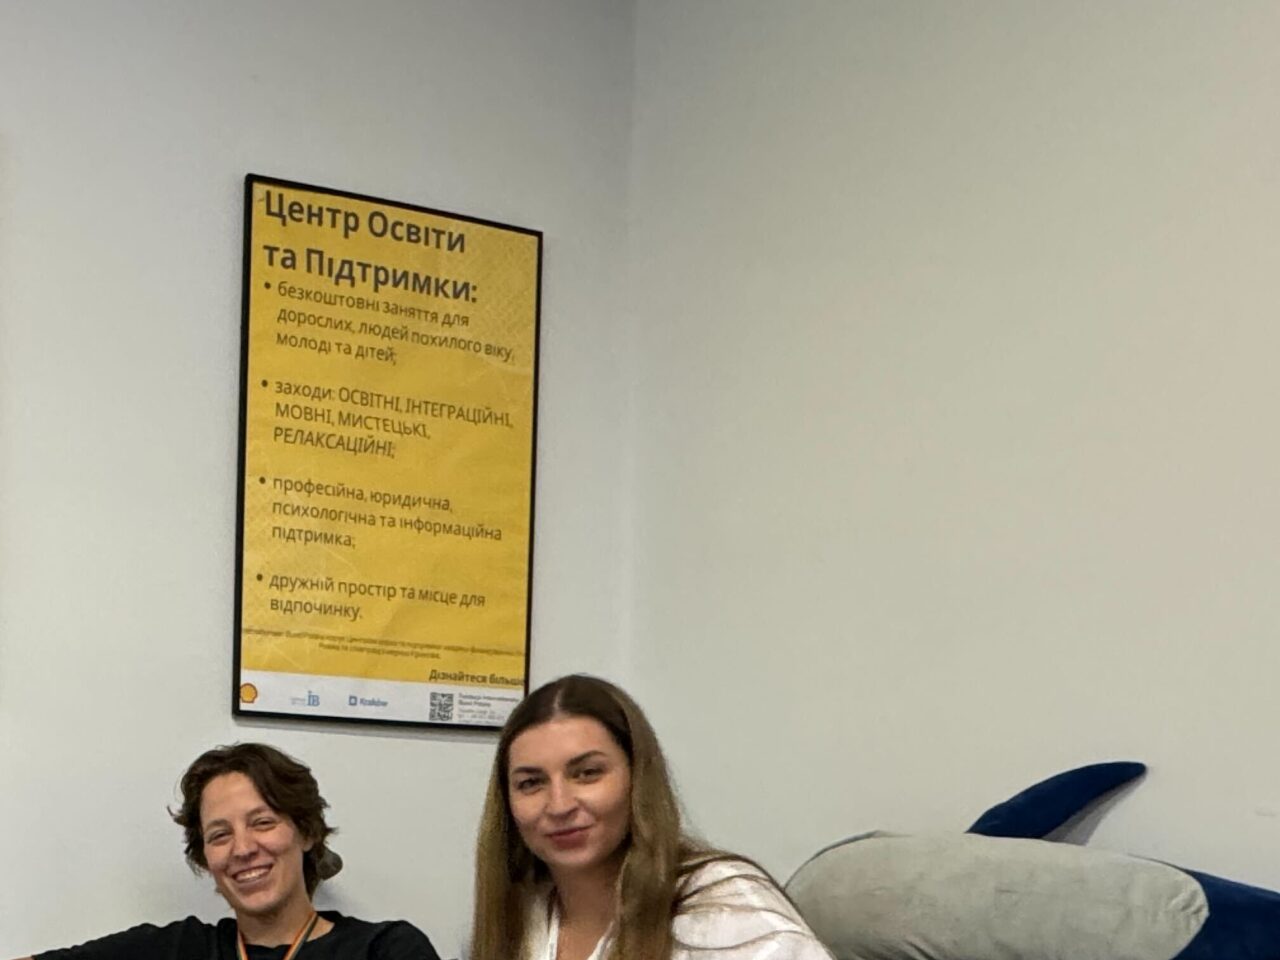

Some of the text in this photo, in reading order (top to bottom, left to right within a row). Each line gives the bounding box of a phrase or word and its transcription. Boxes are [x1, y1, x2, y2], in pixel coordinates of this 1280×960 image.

[265, 190, 466, 253] Центр Освіти
[263, 244, 477, 303] та Підтримки:
[278, 280, 469, 328] безкоштовні заняття для
[276, 333, 397, 365] молоді та дітей;
[277, 307, 355, 334] дорослих,
[359, 321, 409, 341] людей
[411, 331, 482, 353] похилого
[275, 401, 334, 426] МОВНІ,
[273, 475, 453, 513] професійна, юридична,
[272, 500, 502, 541] психологічна та інформаційна
[269, 572, 485, 608] дружній простір та місце для
[270, 599, 363, 621] відпочинку.
